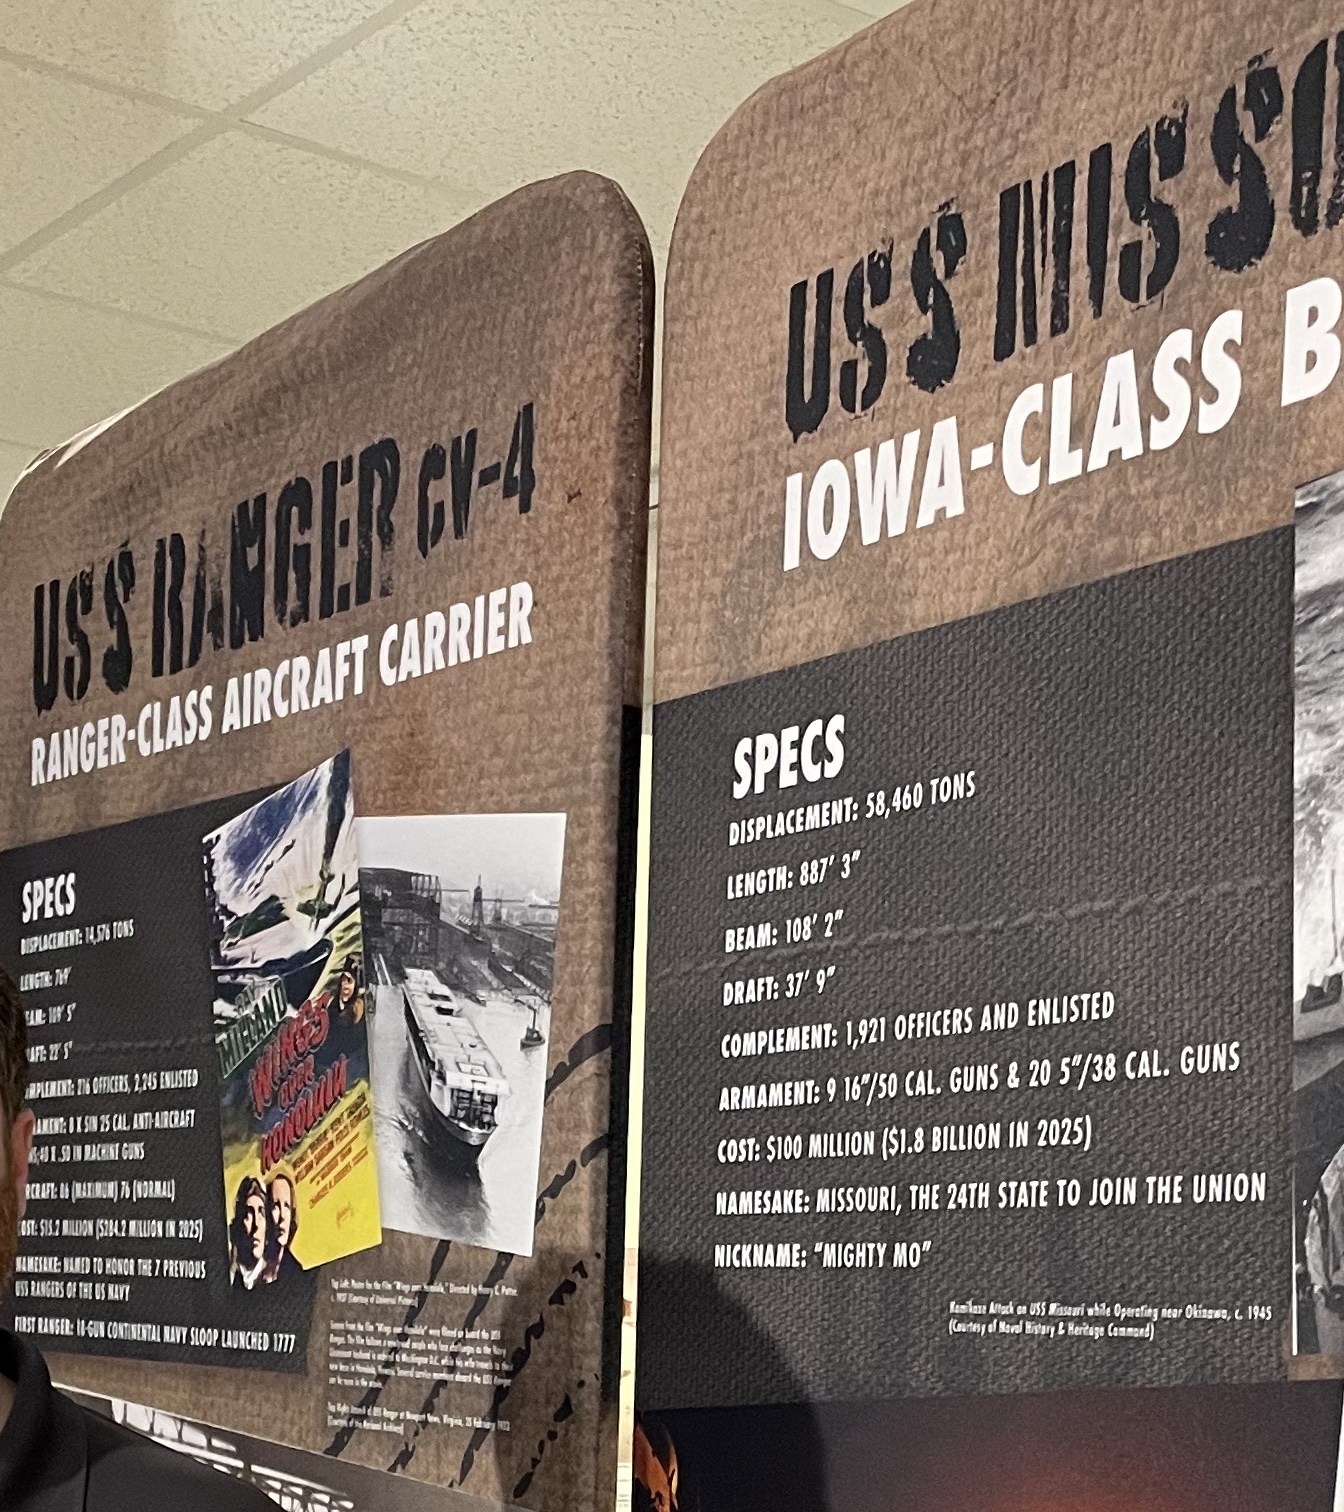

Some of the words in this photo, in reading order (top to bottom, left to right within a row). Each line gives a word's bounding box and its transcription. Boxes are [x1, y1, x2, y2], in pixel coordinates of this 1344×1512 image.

[785, 199, 968, 443] USS
[783, 308, 1243, 572] IOWA-CLASS
[33, 541, 135, 715] USS
[151, 438, 400, 678] RANGER
[417, 402, 534, 559] CV-4
[31, 684, 213, 787] RANGER-CLASS
[221, 634, 369, 734] AIRCRAFT
[379, 581, 534, 686] CARRIER
[733, 714, 845, 800] SPECS
[728, 796, 859, 847] DISPLACEMENT:
[865, 781, 923, 820] 58,460
[929, 770, 976, 805] TONS
[22, 872, 76, 924] SPECS
[727, 865, 794, 900] LENGTH:
[725, 922, 778, 953] BEAM:
[723, 976, 779, 1007] DRAFT:
[721, 1022, 838, 1059] COMPLEMENT:
[846, 1016, 886, 1051] 1,921
[894, 1006, 973, 1041] OFFICERS
[980, 1002, 1019, 1032] AND
[1027, 991, 1115, 1027] ENLISTED
[718, 1079, 820, 1112] ARMAMENT:
[826, 1077, 837, 1103] 9
[904, 1069, 942, 1097] CAL.
[949, 1063, 999, 1094] GUNS
[1007, 1061, 1020, 1089] &
[1028, 1059, 1051, 1087] 20
[1125, 1049, 1170, 1080] CAL.
[1180, 1041, 1240, 1075] GUNS
[717, 1137, 761, 1164] COST:
[766, 1134, 803, 1163] $100
[808, 1130, 875, 1159] MILLION
[881, 1126, 925, 1161] ($1.8
[931, 1122, 1001, 1152] BILLION
[1008, 1120, 1029, 1148] IN
[1037, 1114, 1092, 1152] 2025)
[716, 1189, 810, 1216] NAMESAKE:
[815, 1185, 902, 1216] MISSOURI,
[909, 1183, 940, 1210] THE
[947, 1182, 990, 1210] 24TH
[998, 1180, 1049, 1209] STATE
[1056, 1179, 1081, 1207] TO
[1088, 1176, 1137, 1206] JOIN
[1145, 1175, 1183, 1204] THE
[1192, 1172, 1266, 1204] UNION
[714, 1243, 807, 1268] NICKNAME:
[1030, 1302, 1046, 1315] USS
[1248, 1305, 1272, 1320] 1945
[163, 1325, 188, 1345] NAVY
[190, 1326, 219, 1347] SLOOP
[221, 1329, 270, 1352] LAUNCHED
[273, 1332, 296, 1354] 1777
